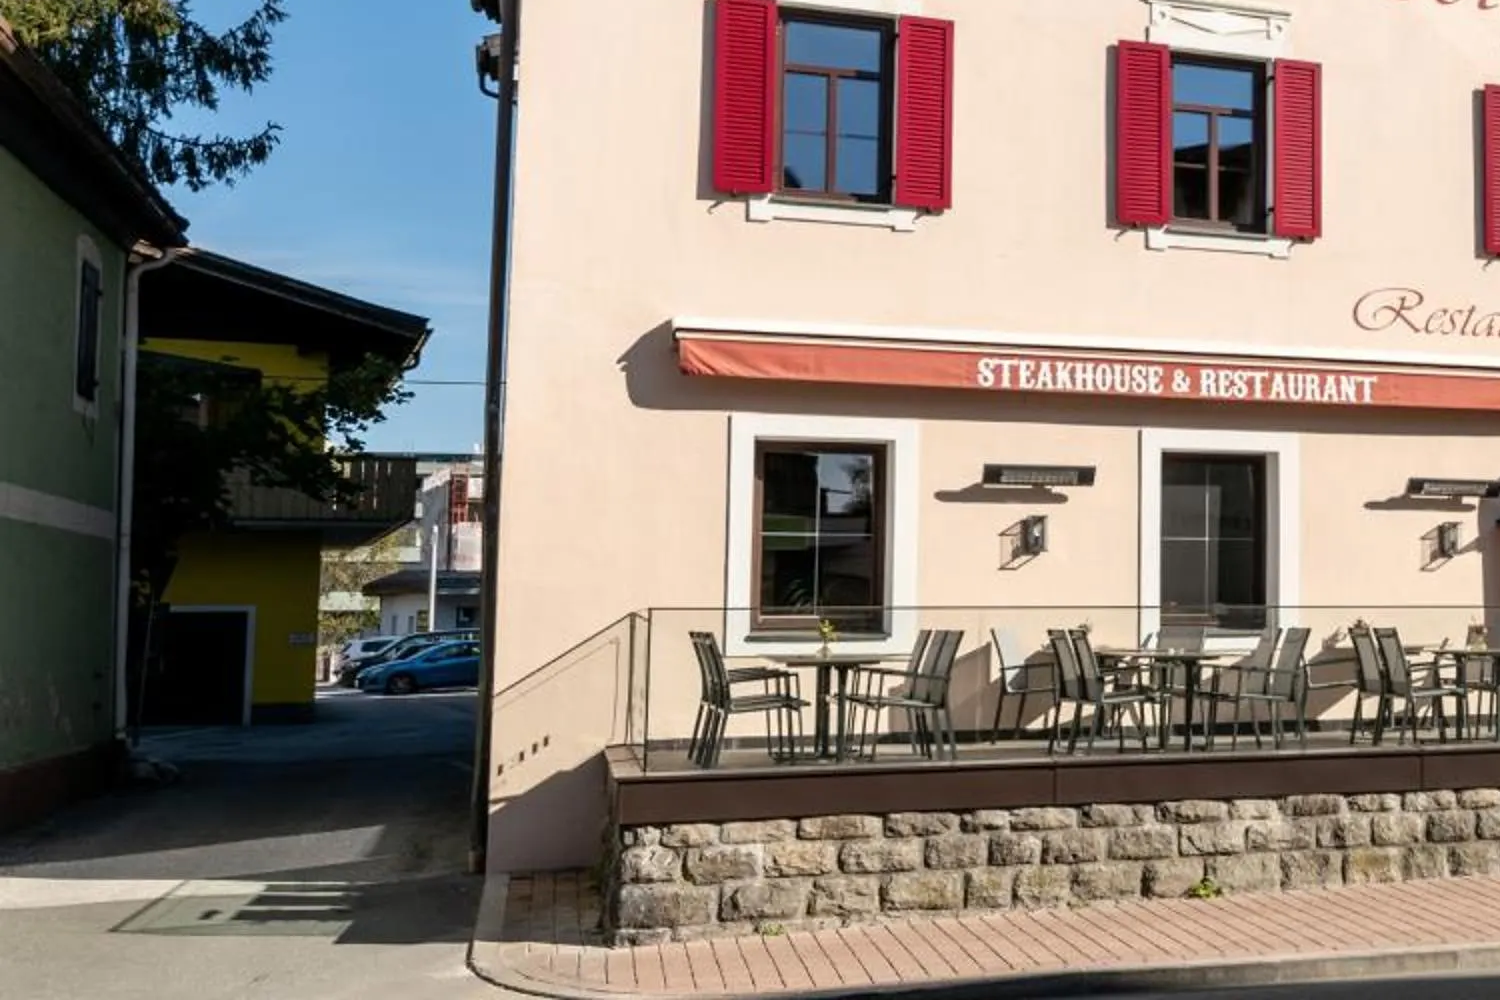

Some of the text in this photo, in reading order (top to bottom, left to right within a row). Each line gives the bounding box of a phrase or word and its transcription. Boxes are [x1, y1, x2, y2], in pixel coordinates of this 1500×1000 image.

[976, 358, 1378, 405] STEAKHOUSE & RESTAURANT
